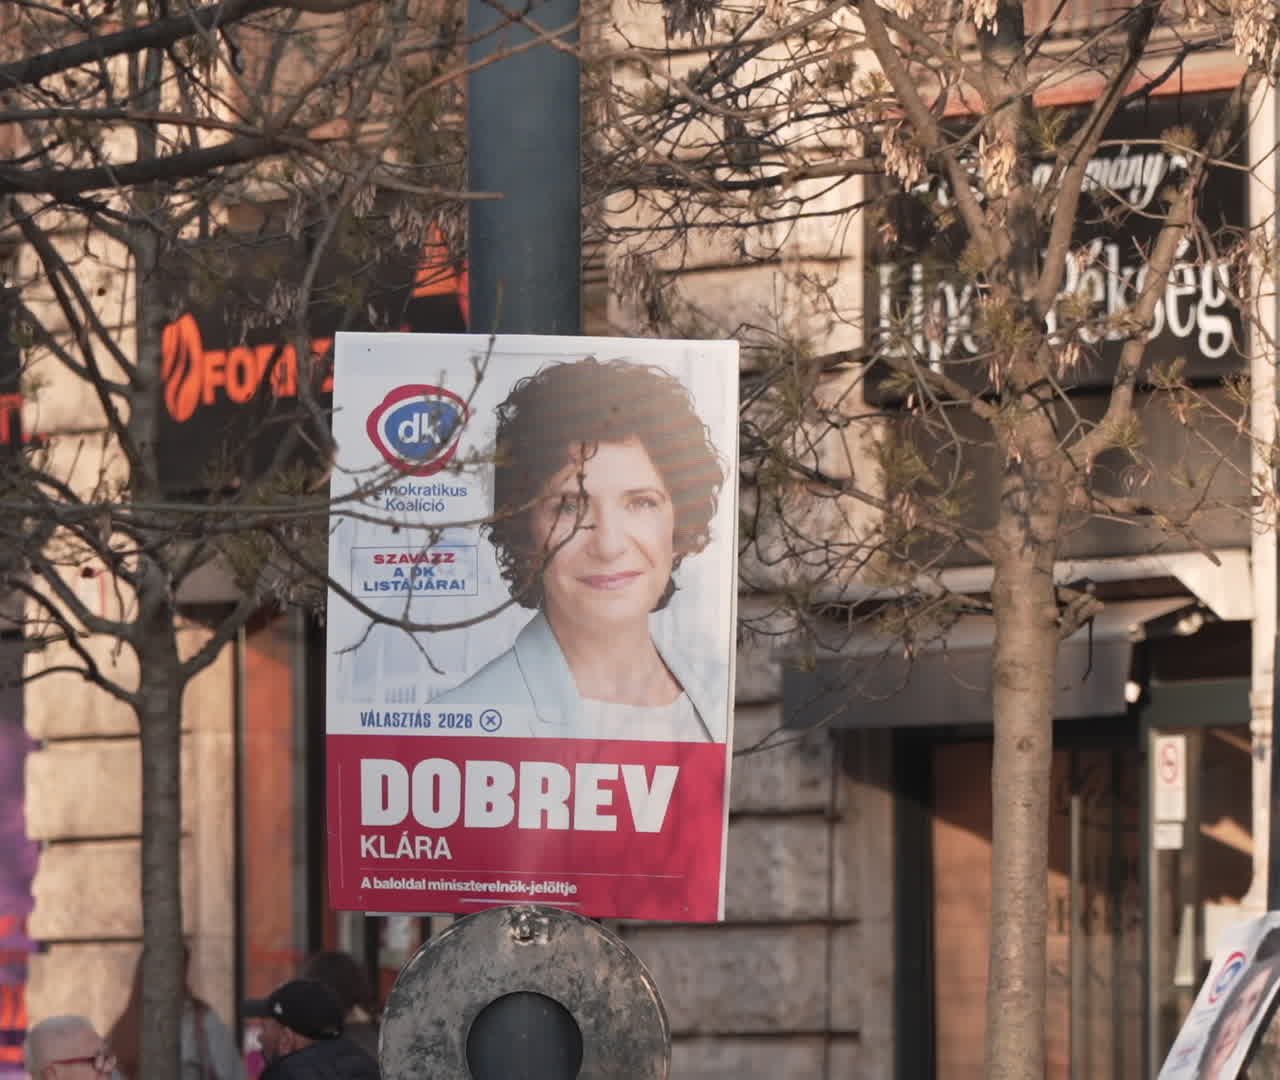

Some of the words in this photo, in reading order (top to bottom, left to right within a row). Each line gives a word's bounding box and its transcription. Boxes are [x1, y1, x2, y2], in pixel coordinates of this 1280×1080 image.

[397, 412, 441, 445] dk
[365, 482, 468, 498] mokratikus
[384, 498, 445, 513] Koalíció
[373, 552, 456, 565] SZAVAZZ
[393, 567, 404, 577] A
[360, 709, 431, 729] VÁLASZTÁS
[438, 712, 473, 729] 2026
[360, 757, 680, 833] DOBREV
[360, 830, 453, 860] KLÁRA
[361, 878, 372, 890] A
[373, 877, 426, 891] baloldal
[428, 879, 577, 896] miniszterelnök-jelöltje
